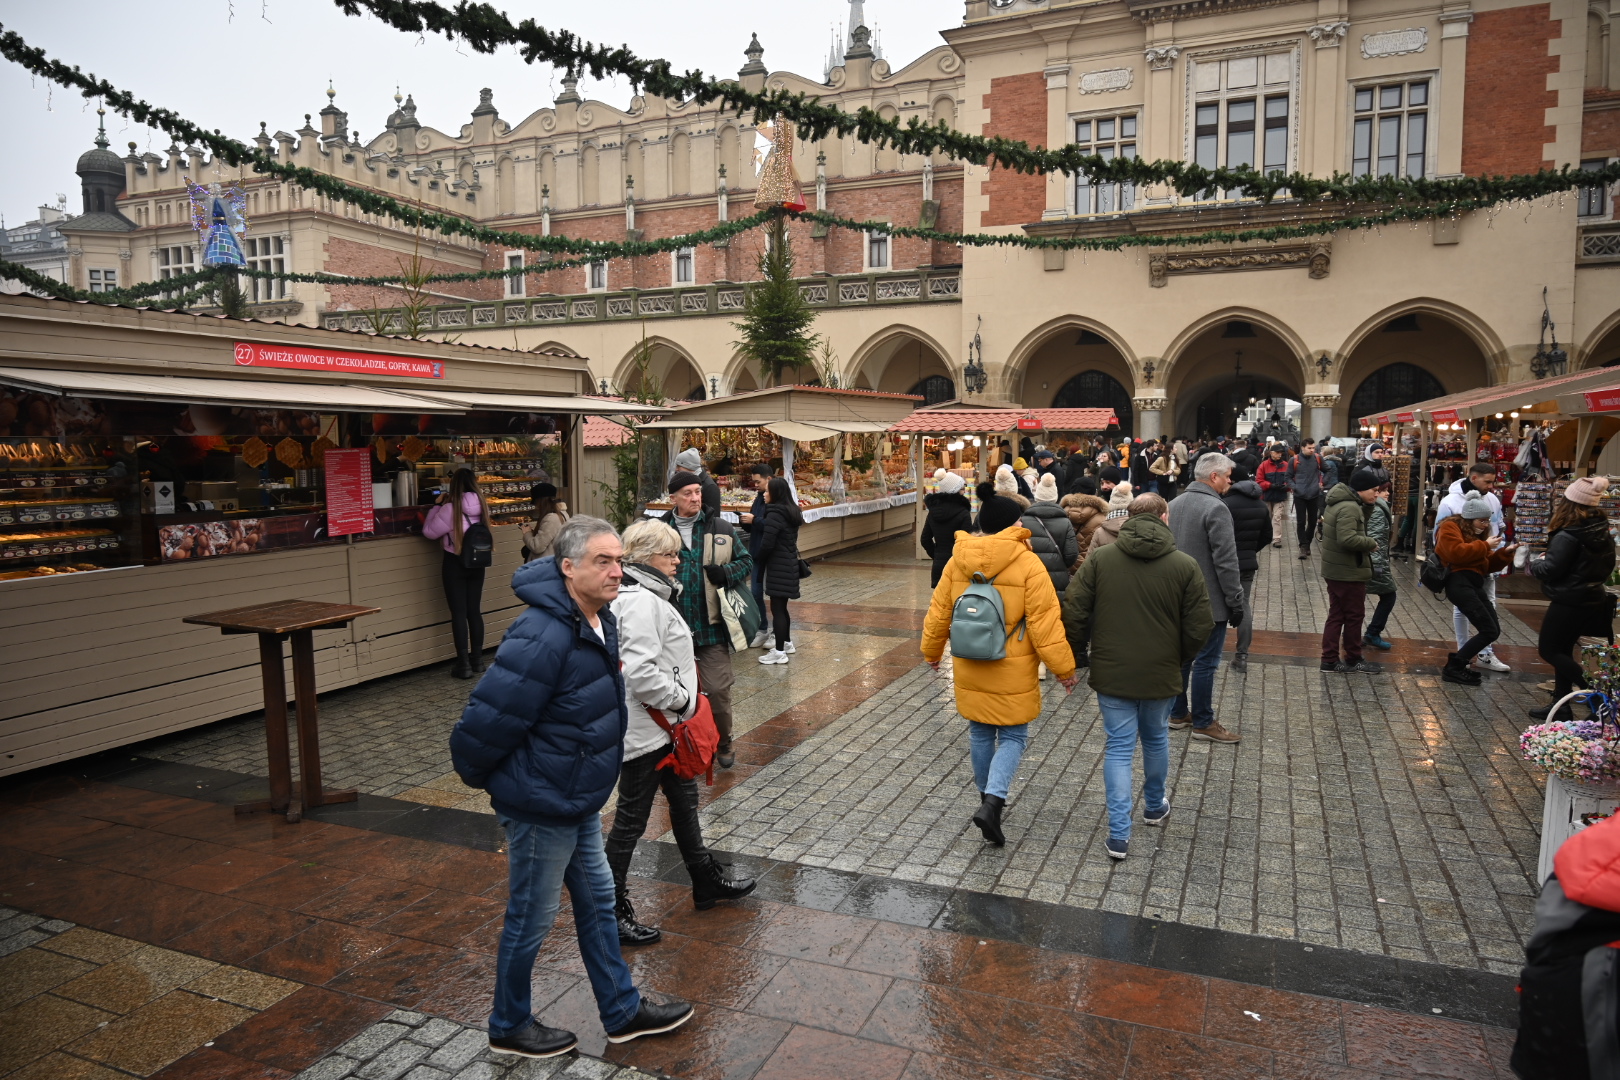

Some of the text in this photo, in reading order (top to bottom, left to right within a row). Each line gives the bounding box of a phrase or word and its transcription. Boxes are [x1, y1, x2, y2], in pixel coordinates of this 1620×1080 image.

[238, 348, 251, 360] 27
[259, 349, 432, 374] ŚWIEŻE OWOCE W CZEKOLADZIE, GOFRY, KAWA
